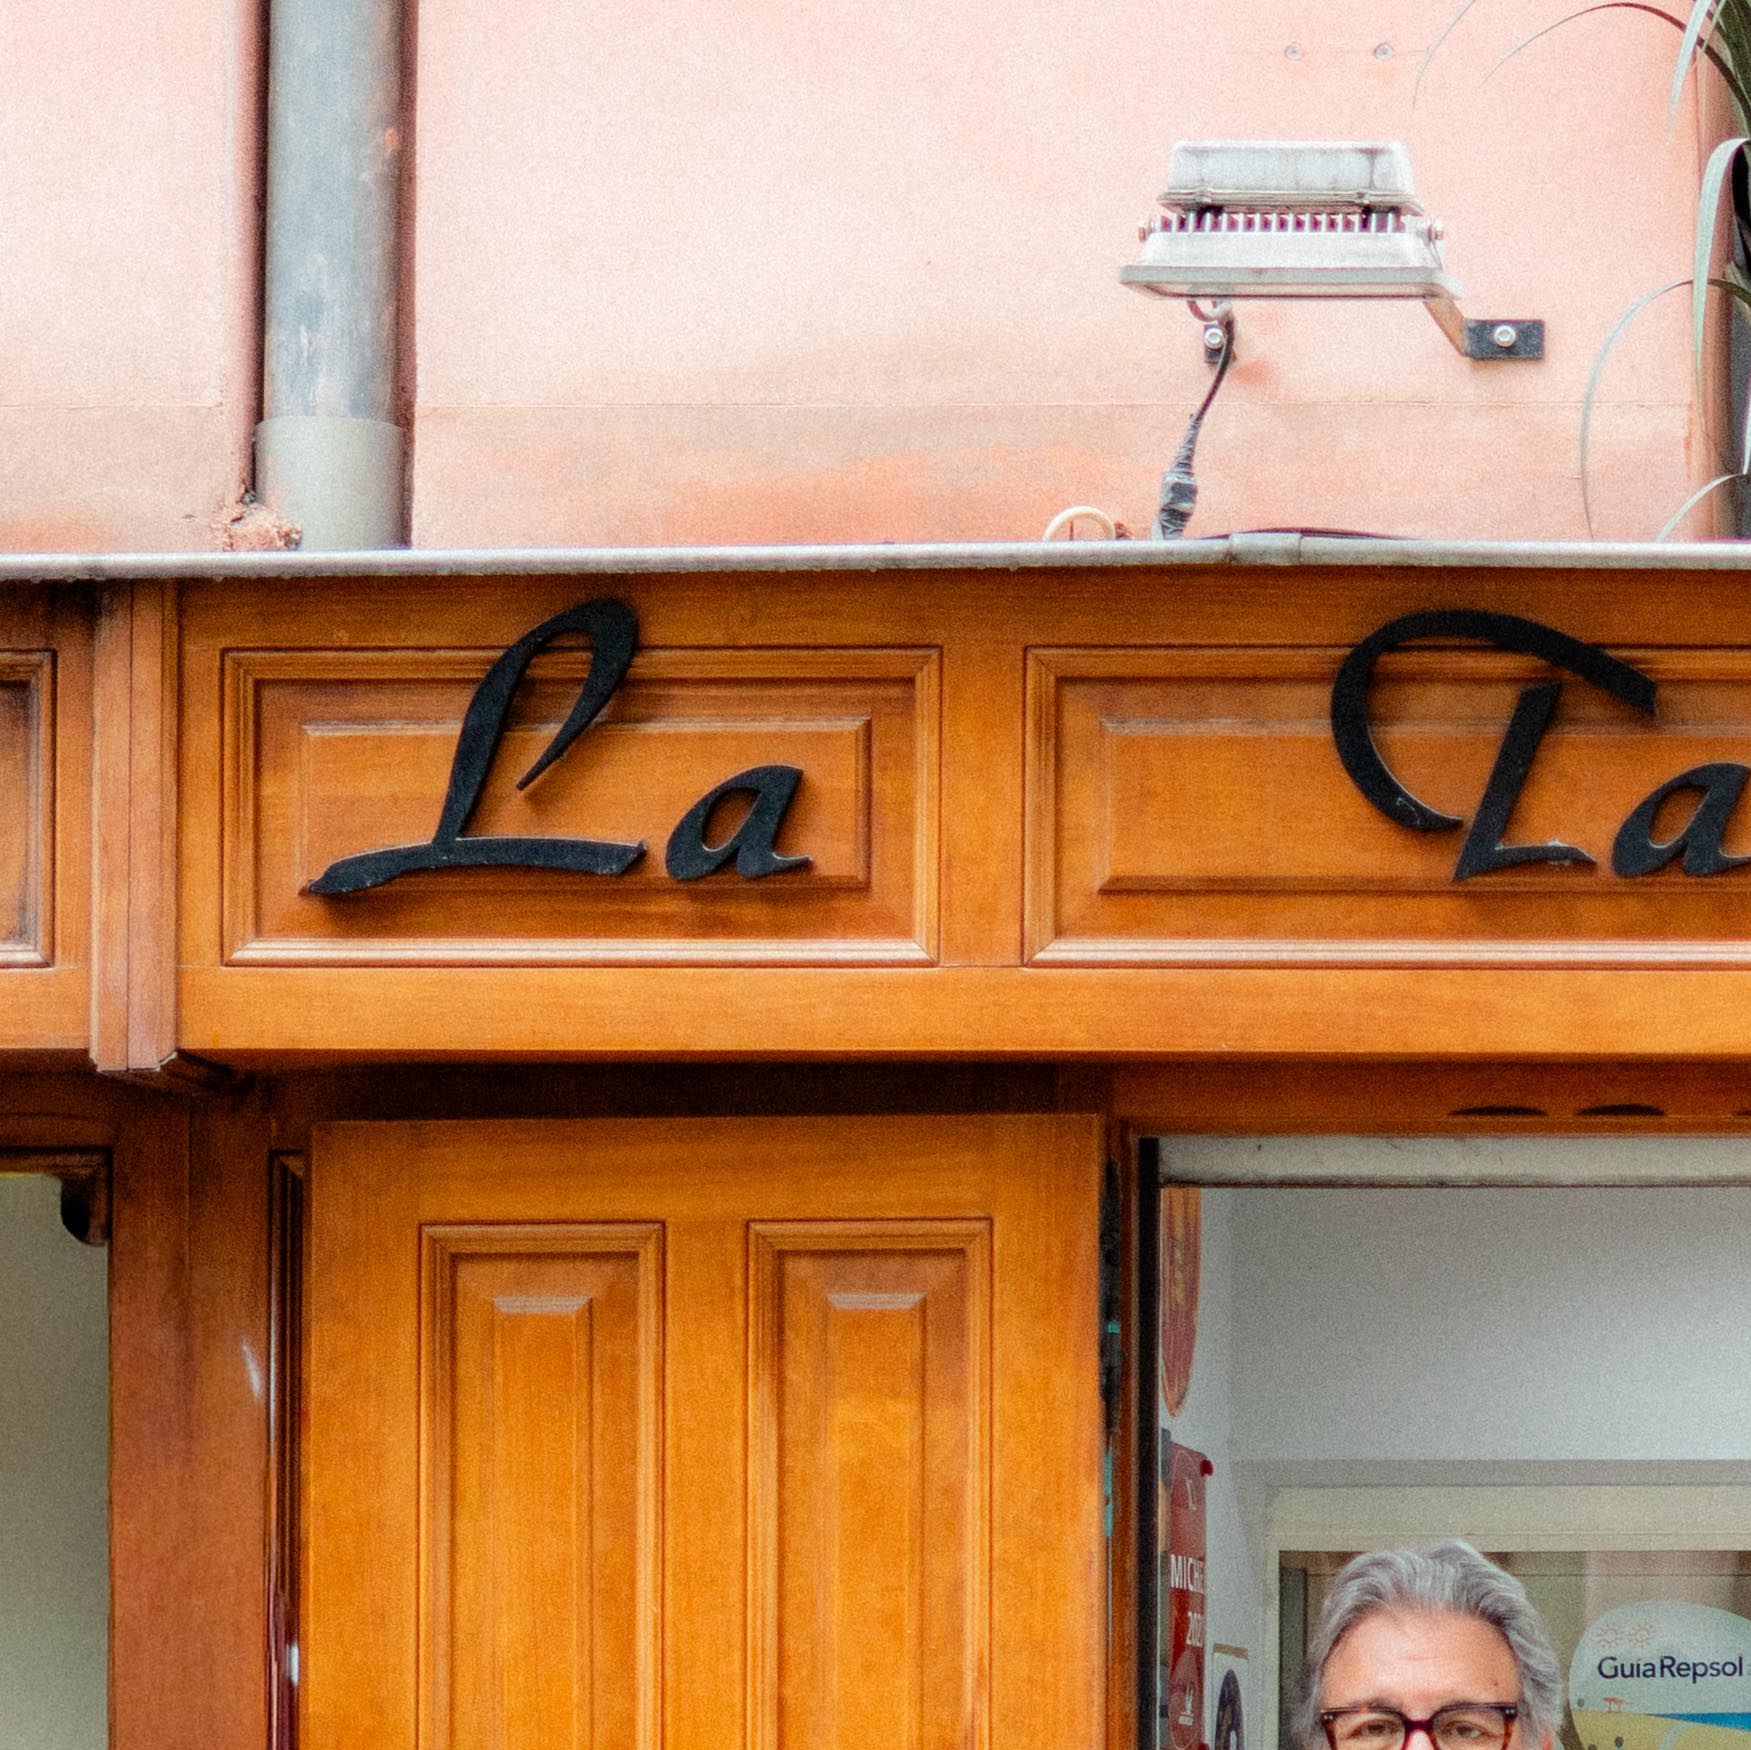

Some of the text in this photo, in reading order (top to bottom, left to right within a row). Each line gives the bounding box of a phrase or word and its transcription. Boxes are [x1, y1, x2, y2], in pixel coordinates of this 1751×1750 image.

[308, 598, 812, 894] La
[1597, 1655, 1657, 1679] Guía
[1660, 1654, 1743, 1684] Repsol
